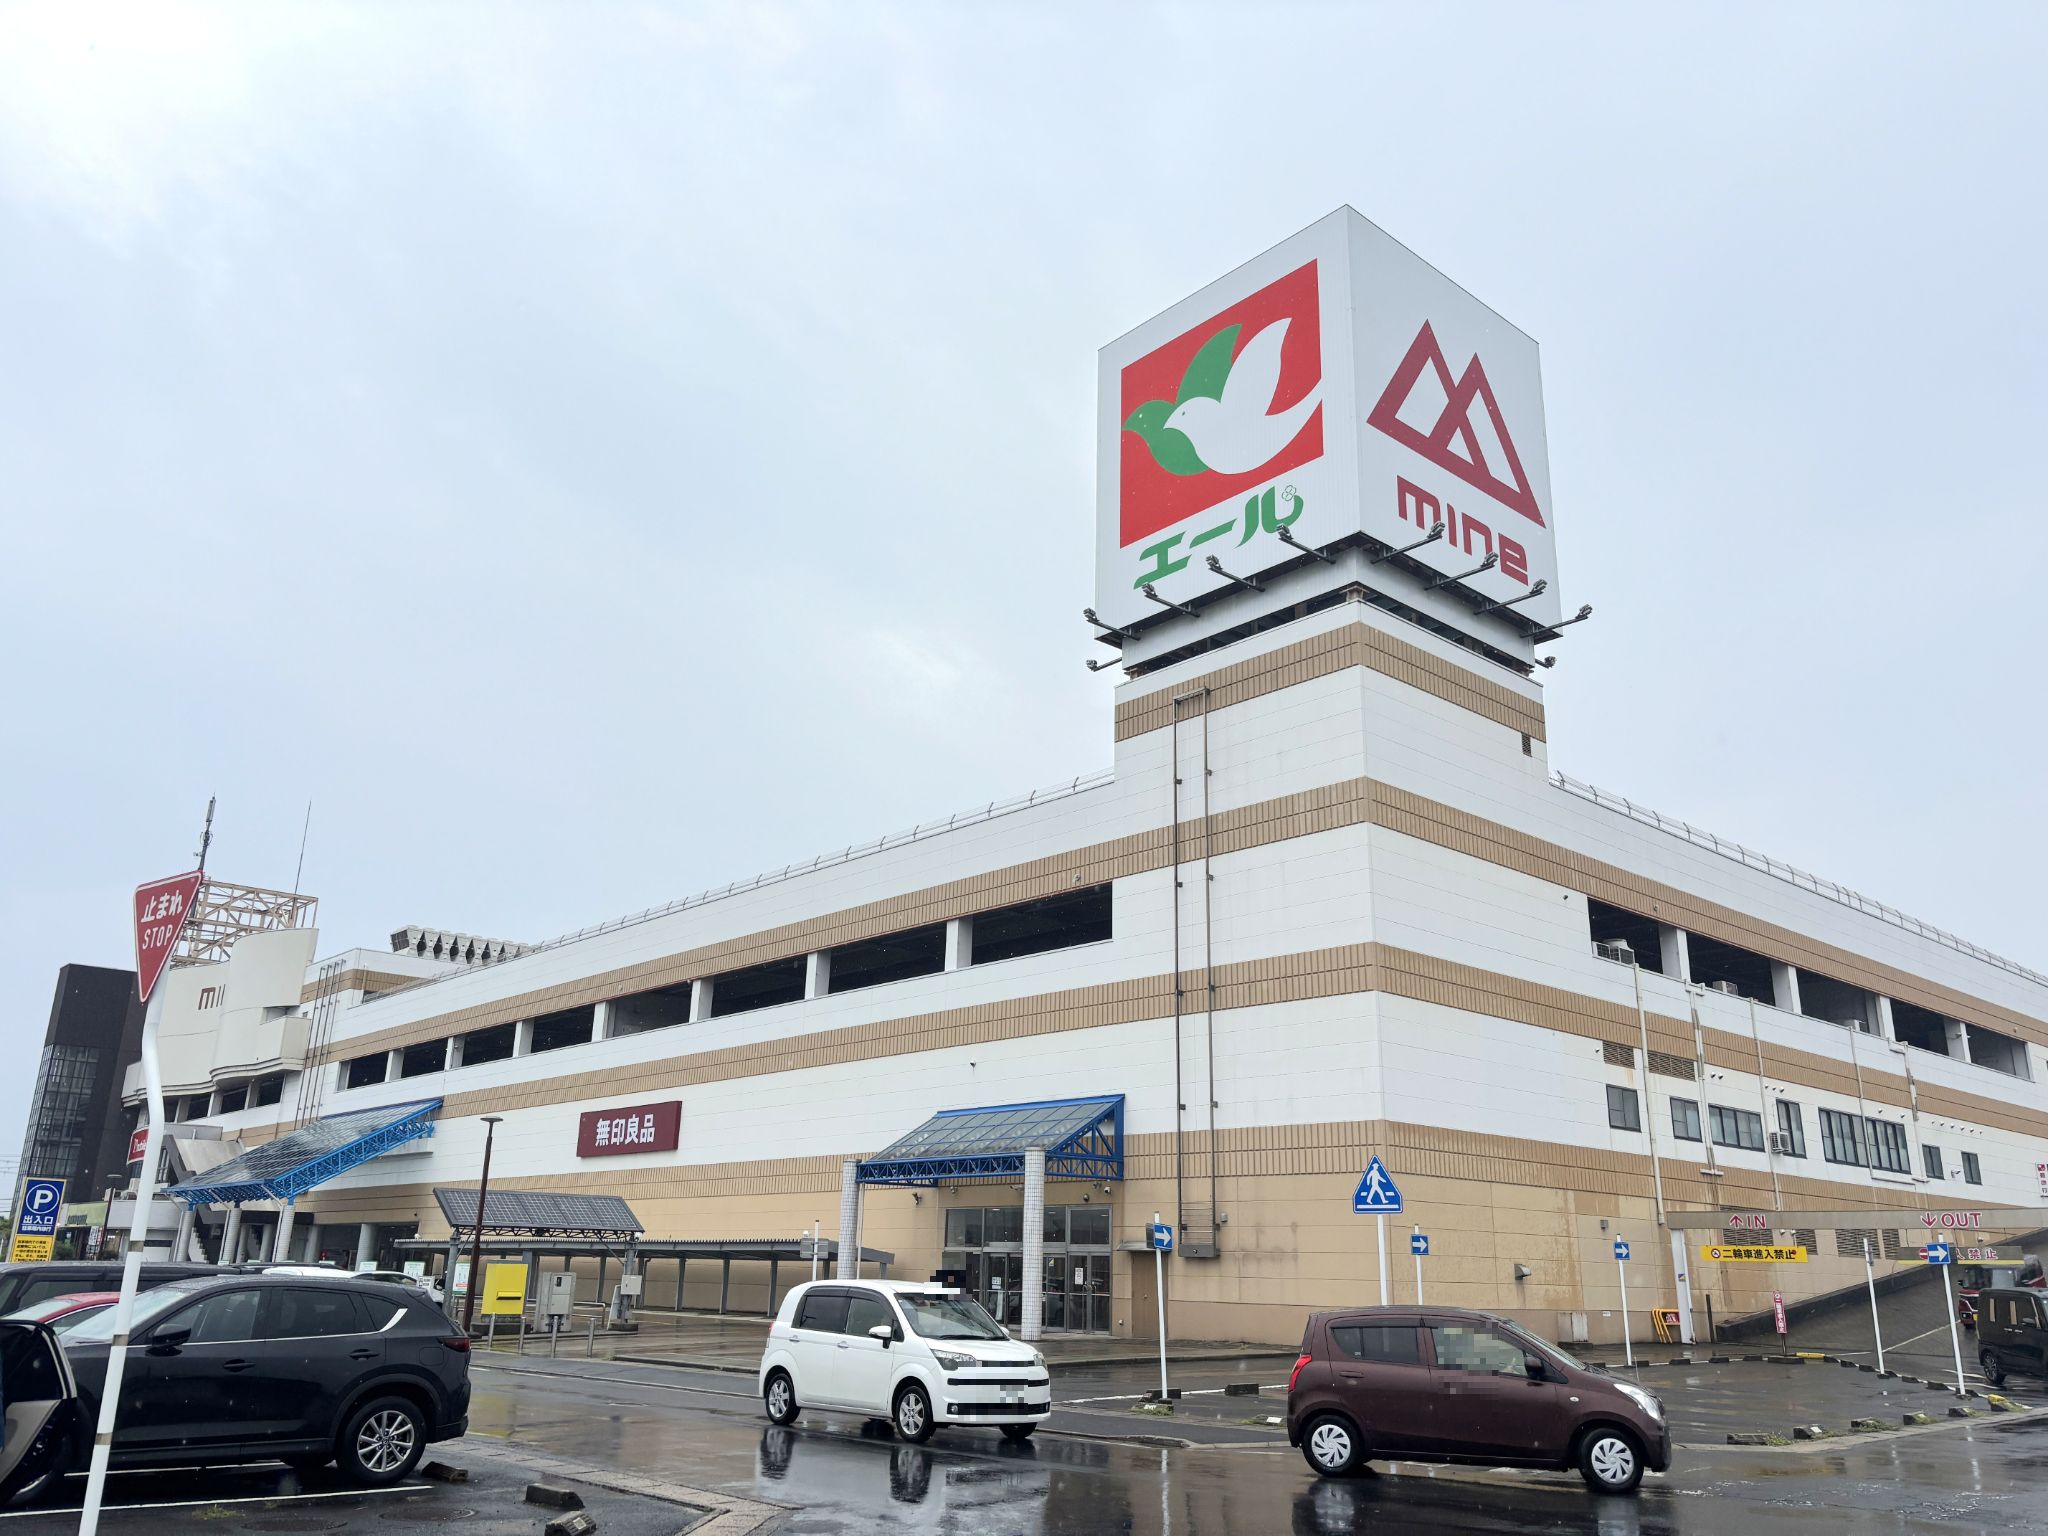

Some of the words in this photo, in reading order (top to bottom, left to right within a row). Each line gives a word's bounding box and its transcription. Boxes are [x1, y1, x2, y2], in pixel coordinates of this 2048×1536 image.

[1133, 485, 1304, 590] エール
[1397, 475, 1529, 586] mine
[141, 890, 182, 922] 止まれ
[142, 924, 173, 949] STOP
[595, 1114, 655, 1147] 無印良品
[33, 1189, 53, 1210] P
[23, 1215, 54, 1225] 出入口
[1746, 1215, 1767, 1229] IN
[1941, 1213, 1982, 1227] OUT
[1722, 1248, 1796, 1260] 二輪車進入禁止
